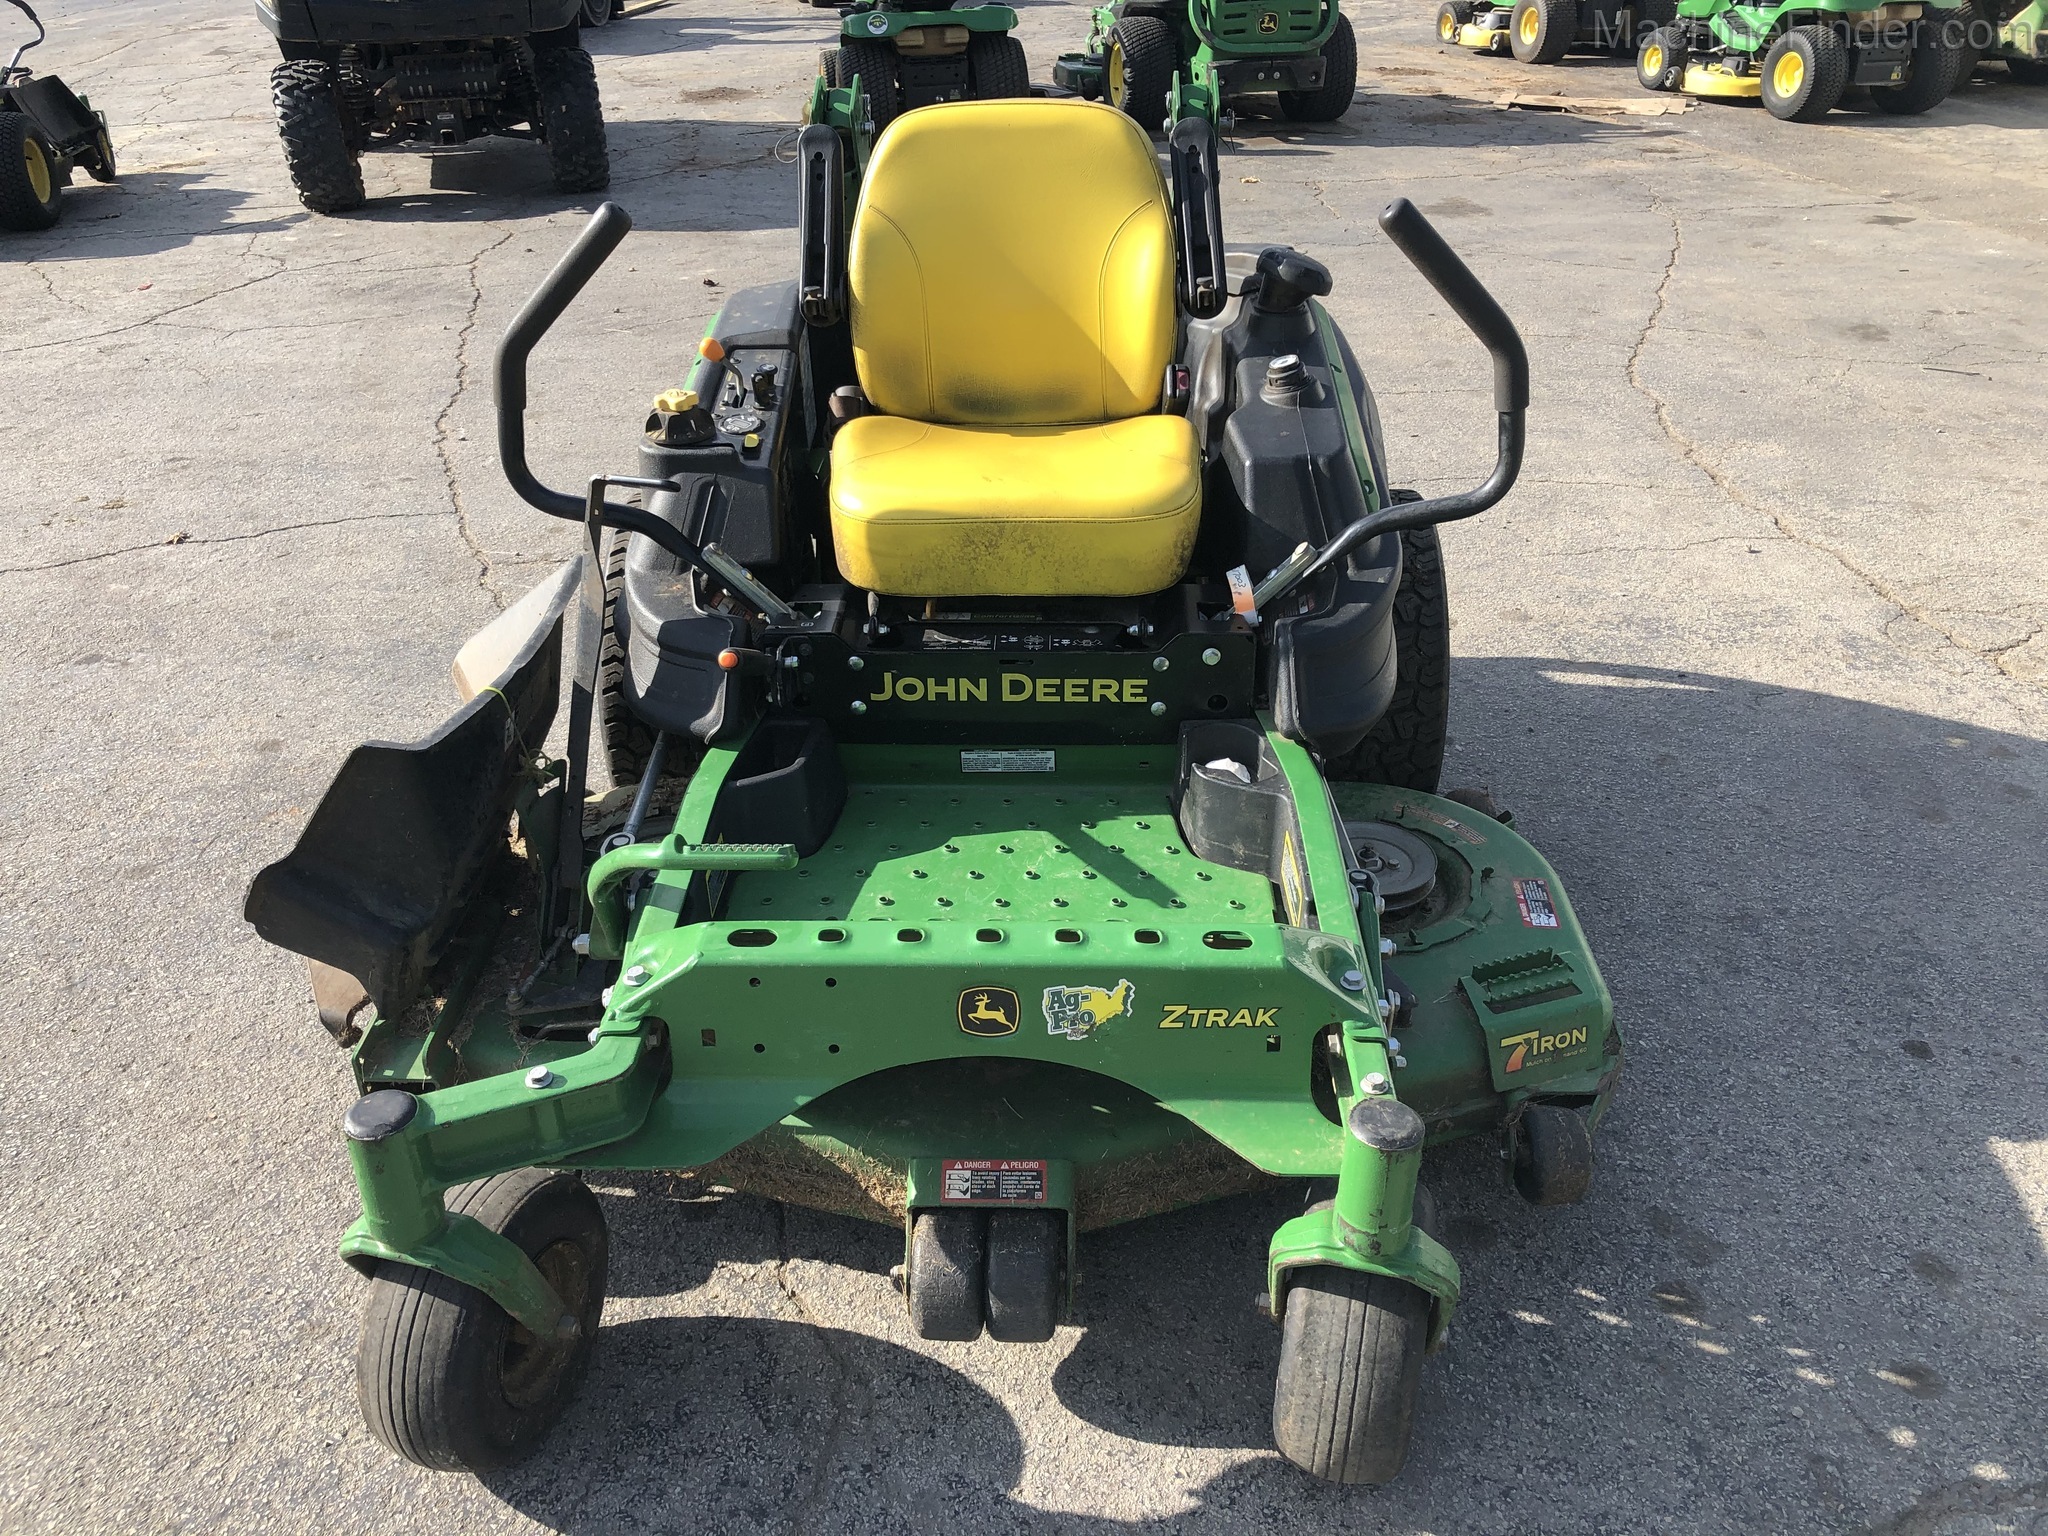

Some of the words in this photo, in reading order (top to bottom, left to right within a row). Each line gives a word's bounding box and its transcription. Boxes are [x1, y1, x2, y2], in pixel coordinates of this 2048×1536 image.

[870, 672, 988, 702] JOHN
[1001, 673, 1148, 703] DEERE
[964, 1161, 991, 1169] DANGER
[1010, 1161, 1039, 1169] PELIGRO
